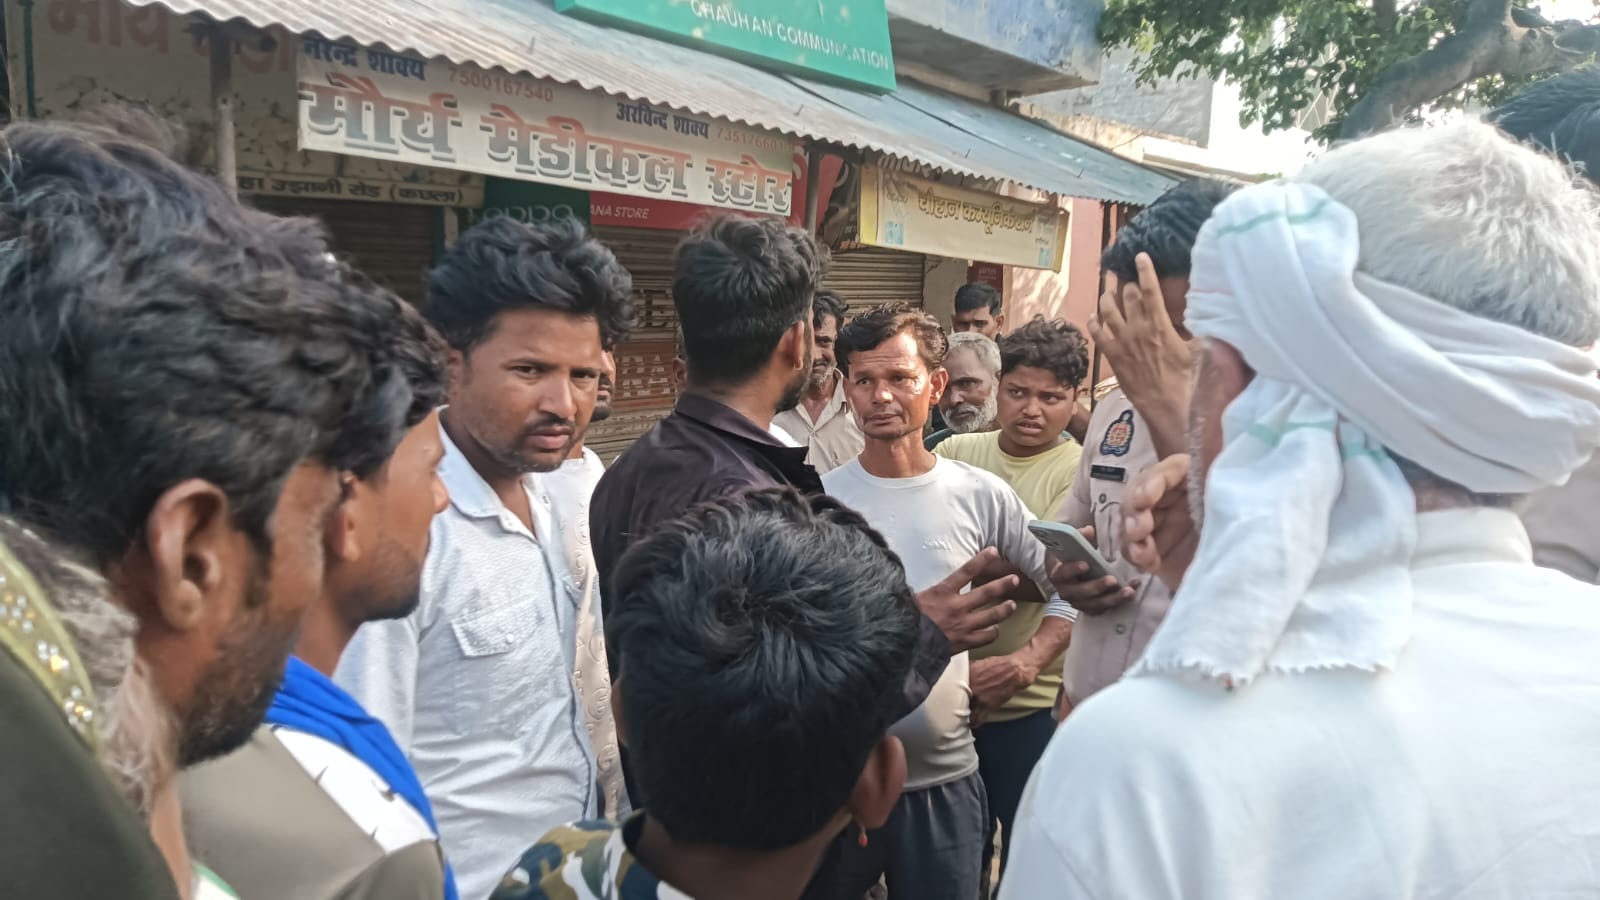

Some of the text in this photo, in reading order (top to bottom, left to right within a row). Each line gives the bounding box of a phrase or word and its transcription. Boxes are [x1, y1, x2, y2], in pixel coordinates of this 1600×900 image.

[690, 0, 774, 39] CHAUHAN
[616, 102, 710, 139] अरविन्द शाक्य
[298, 72, 792, 214] मौर्य मेडीकल स्टोर
[614, 205, 650, 220] STORE
[918, 187, 961, 220] चौहान
